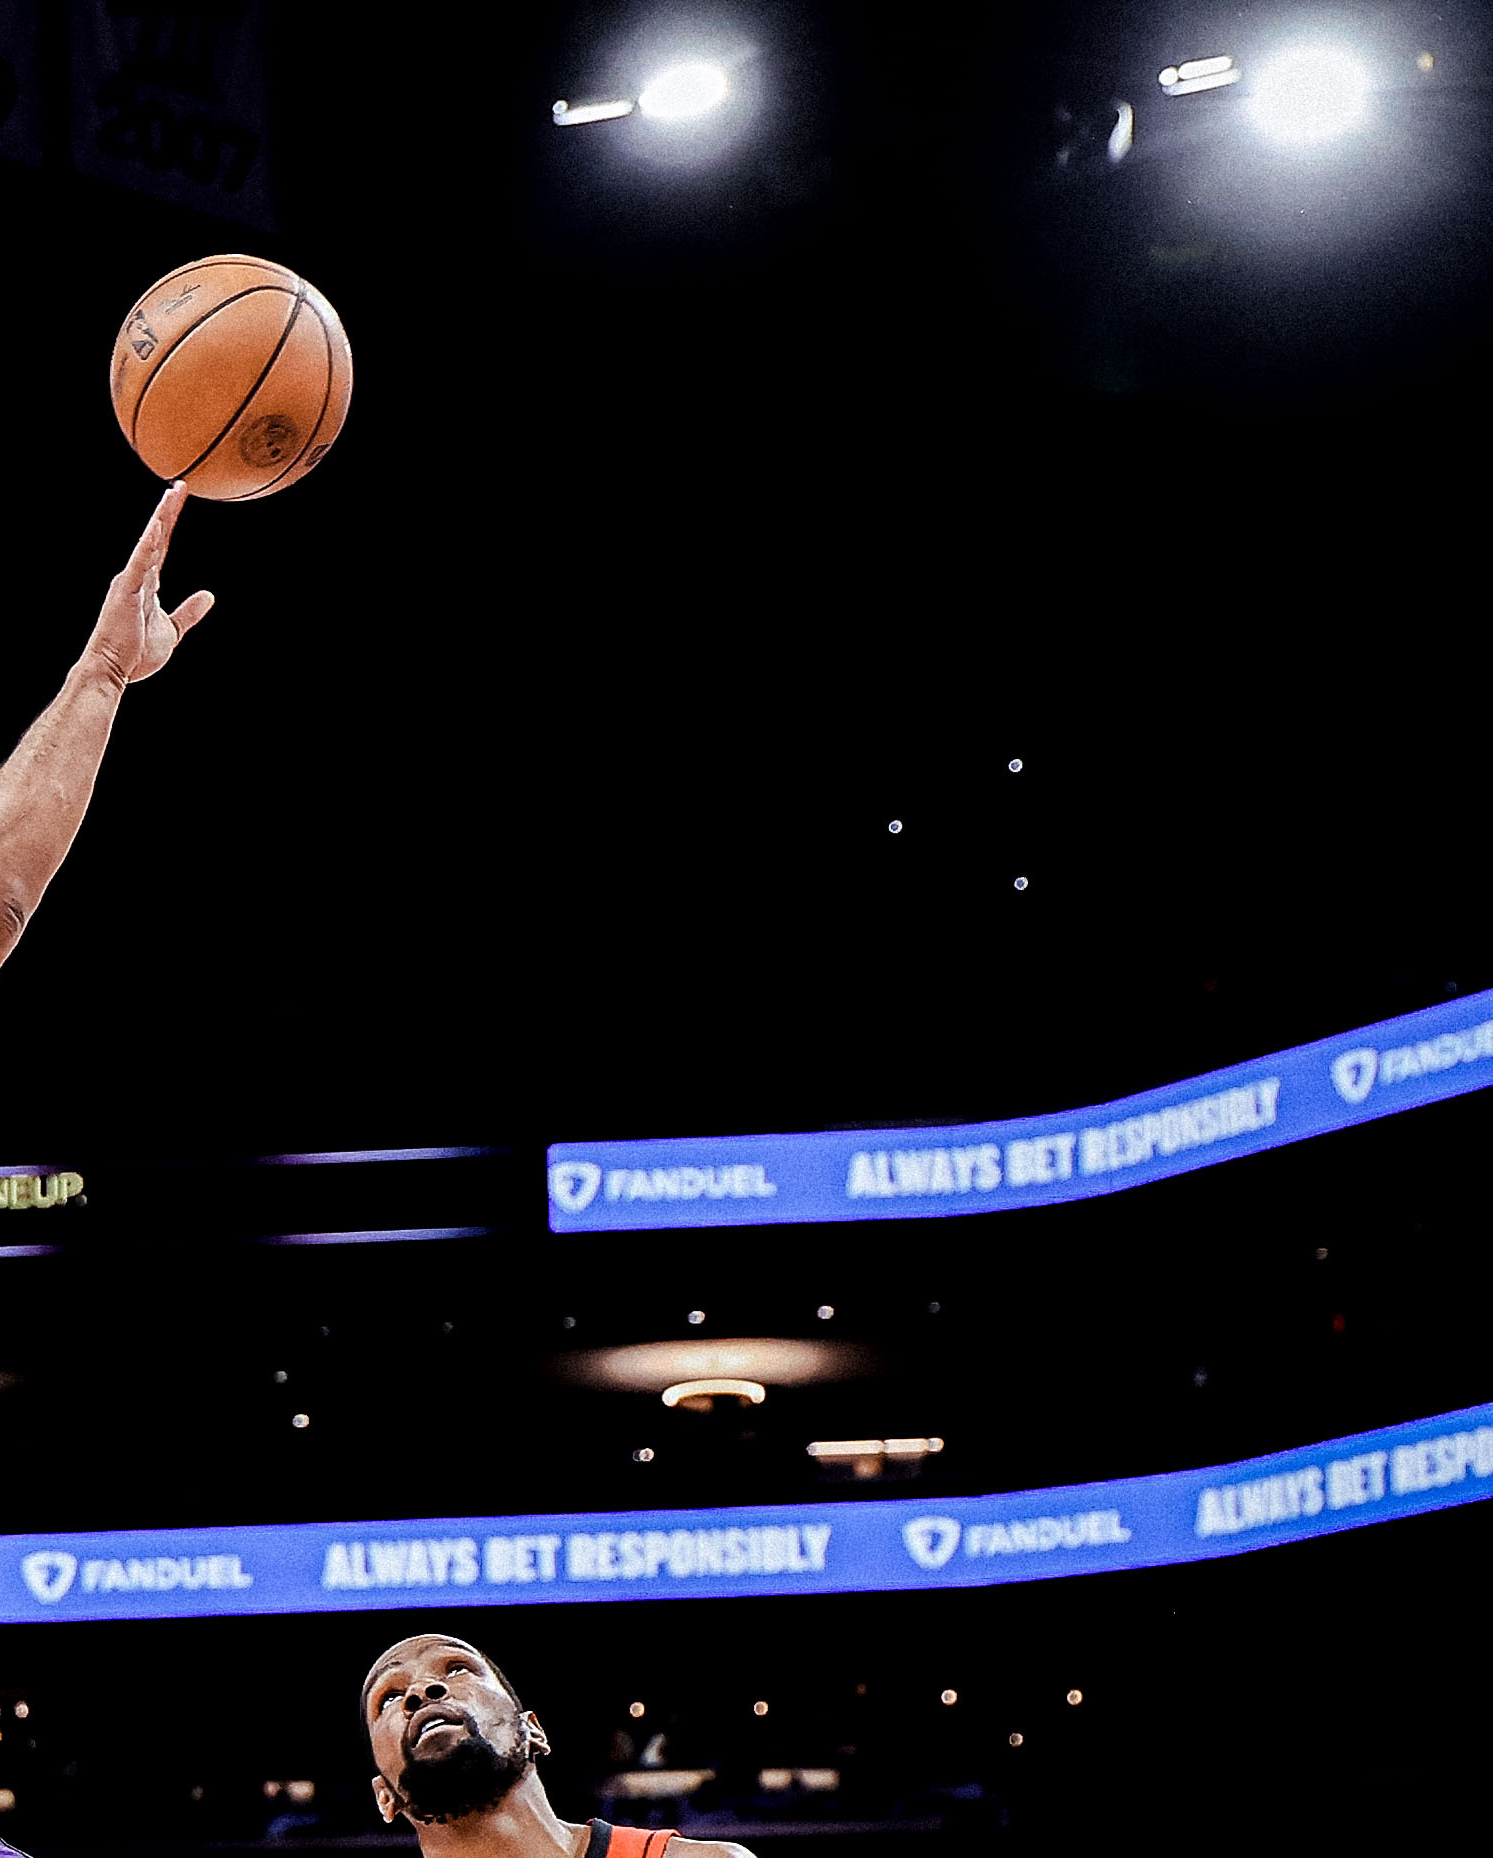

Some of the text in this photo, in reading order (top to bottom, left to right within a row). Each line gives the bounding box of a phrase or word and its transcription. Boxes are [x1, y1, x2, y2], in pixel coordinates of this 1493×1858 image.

[846, 1076, 1281, 1199] ALWAYS BET RESPONSIBLY
[606, 1164, 777, 1202] FANDUEL
[1193, 1465, 1325, 1539] ALWAYS
[1325, 1450, 1388, 1511] BET
[320, 1523, 832, 1590] ALWAYS BET RESPONSIBLY
[963, 1508, 1132, 1557] FANDUEL
[80, 1554, 253, 1595] FANDUEL
